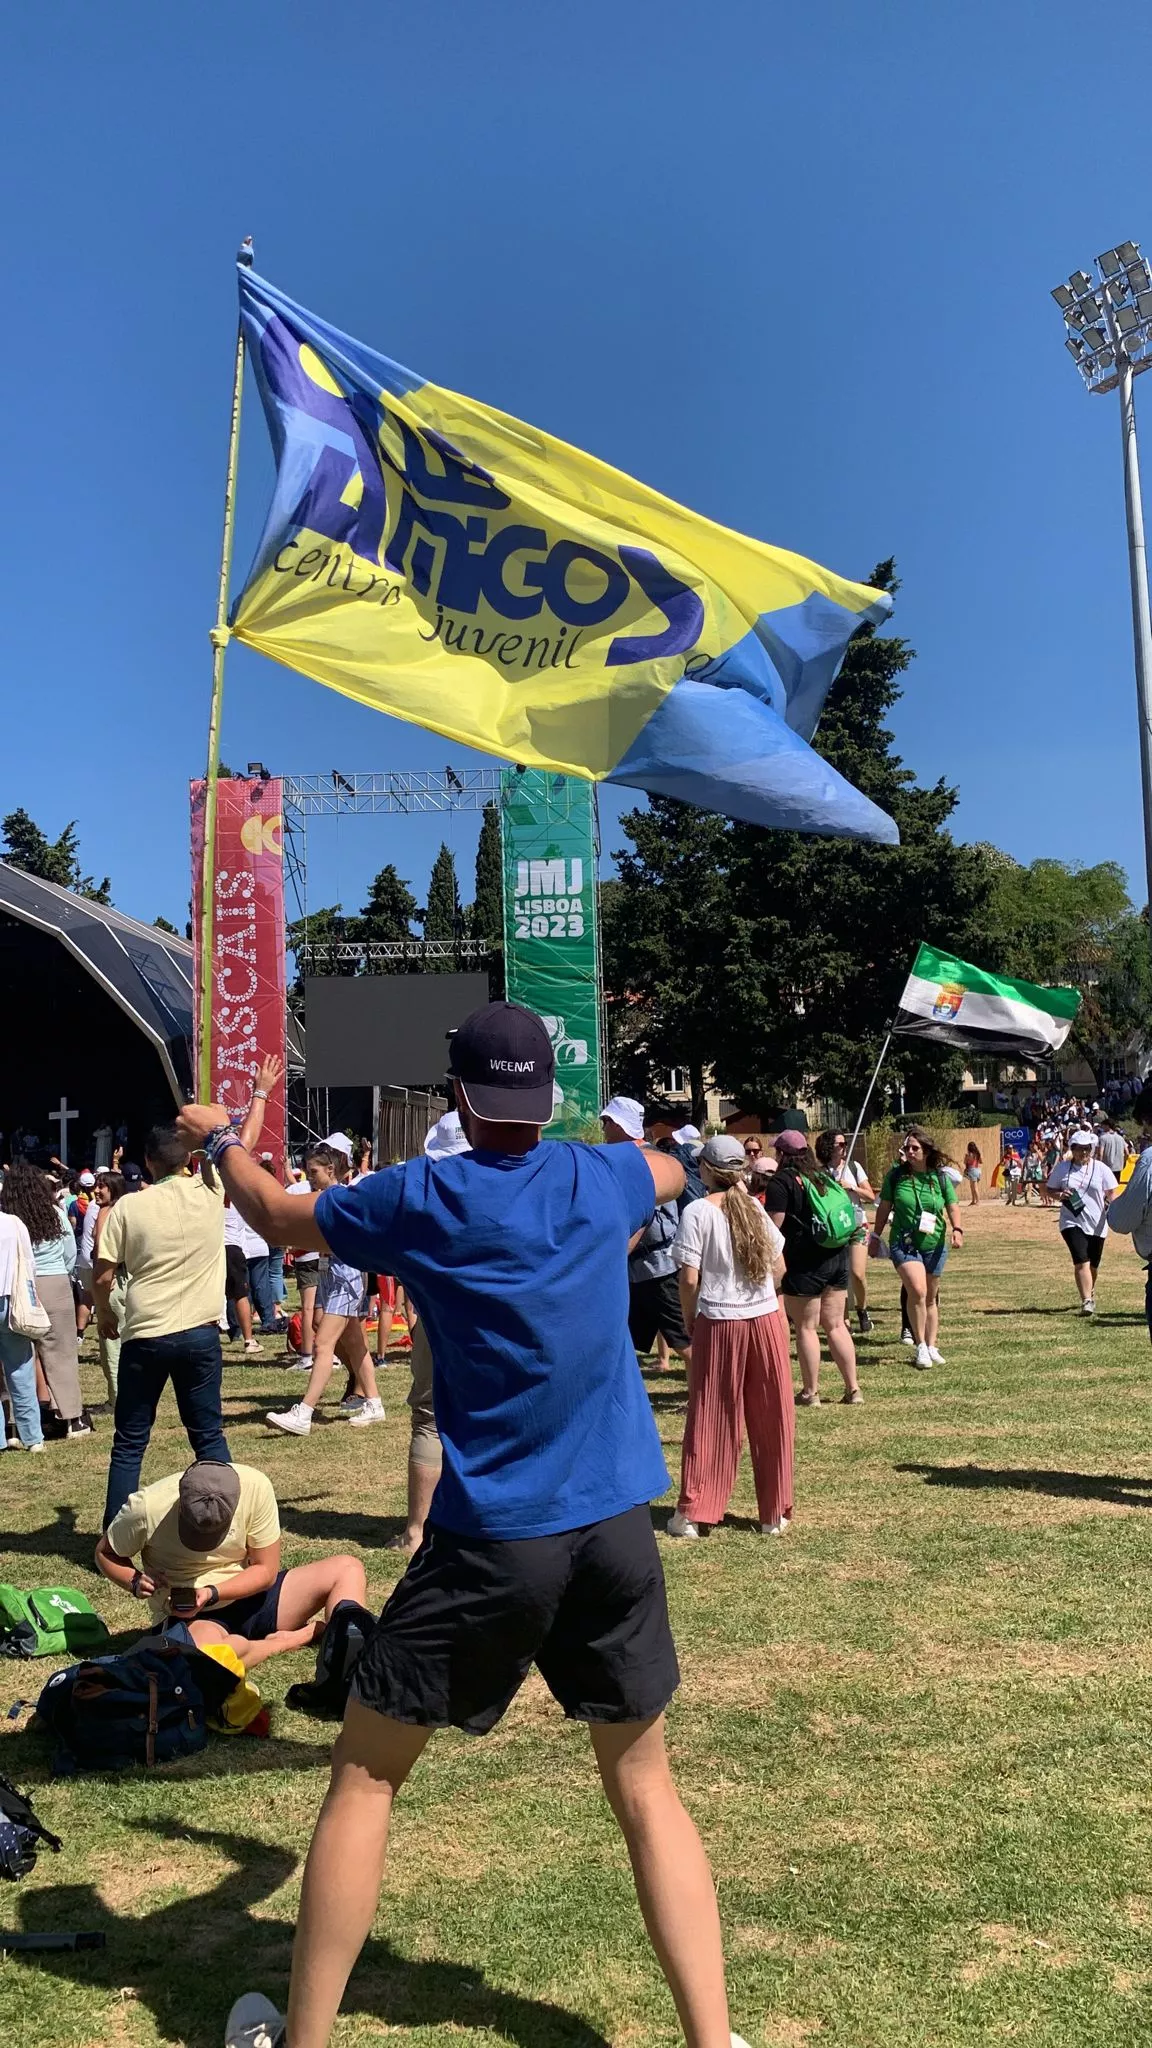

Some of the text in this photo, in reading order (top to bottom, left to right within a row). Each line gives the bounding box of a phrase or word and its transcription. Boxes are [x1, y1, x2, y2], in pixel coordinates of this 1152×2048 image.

[417, 604, 584, 669] juvenil
[514, 858, 583, 897] JMJ
[514, 898, 584, 915] LISBOA
[514, 914, 585, 939] 2023
[215, 870, 258, 1116] CASCAIS
[489, 1058, 536, 1073] WEENAT
